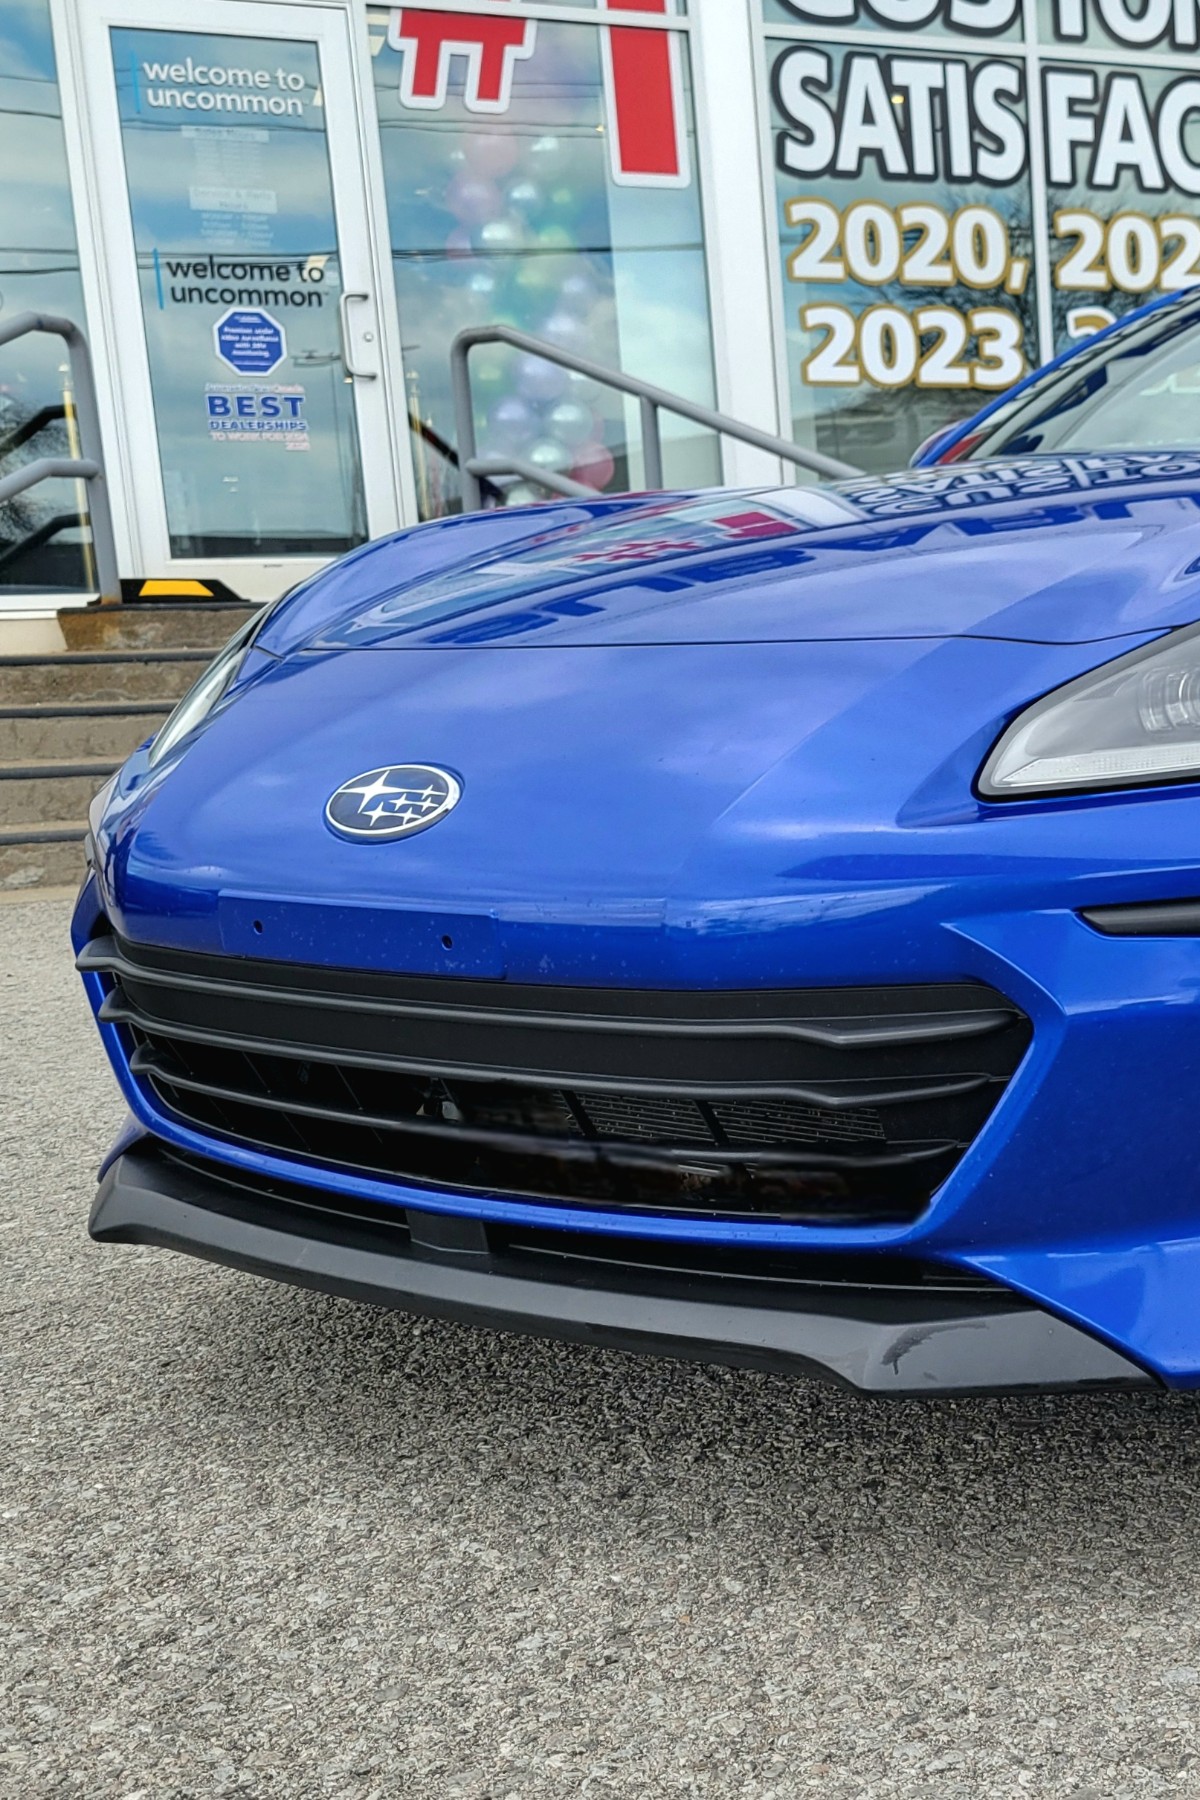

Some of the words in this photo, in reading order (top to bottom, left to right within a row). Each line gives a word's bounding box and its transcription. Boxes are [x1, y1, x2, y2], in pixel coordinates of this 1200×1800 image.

[143, 57, 271, 88] welcome
[276, 68, 305, 91] to
[147, 87, 304, 116] uncommon
[784, 198, 1028, 294] 2020,
[166, 254, 291, 282] welcome
[297, 262, 324, 283] to
[171, 286, 323, 307] uncommon
[799, 303, 1025, 391] 2023
[207, 395, 305, 418] BEST
[209, 420, 307, 431] DEALERSHIPS
